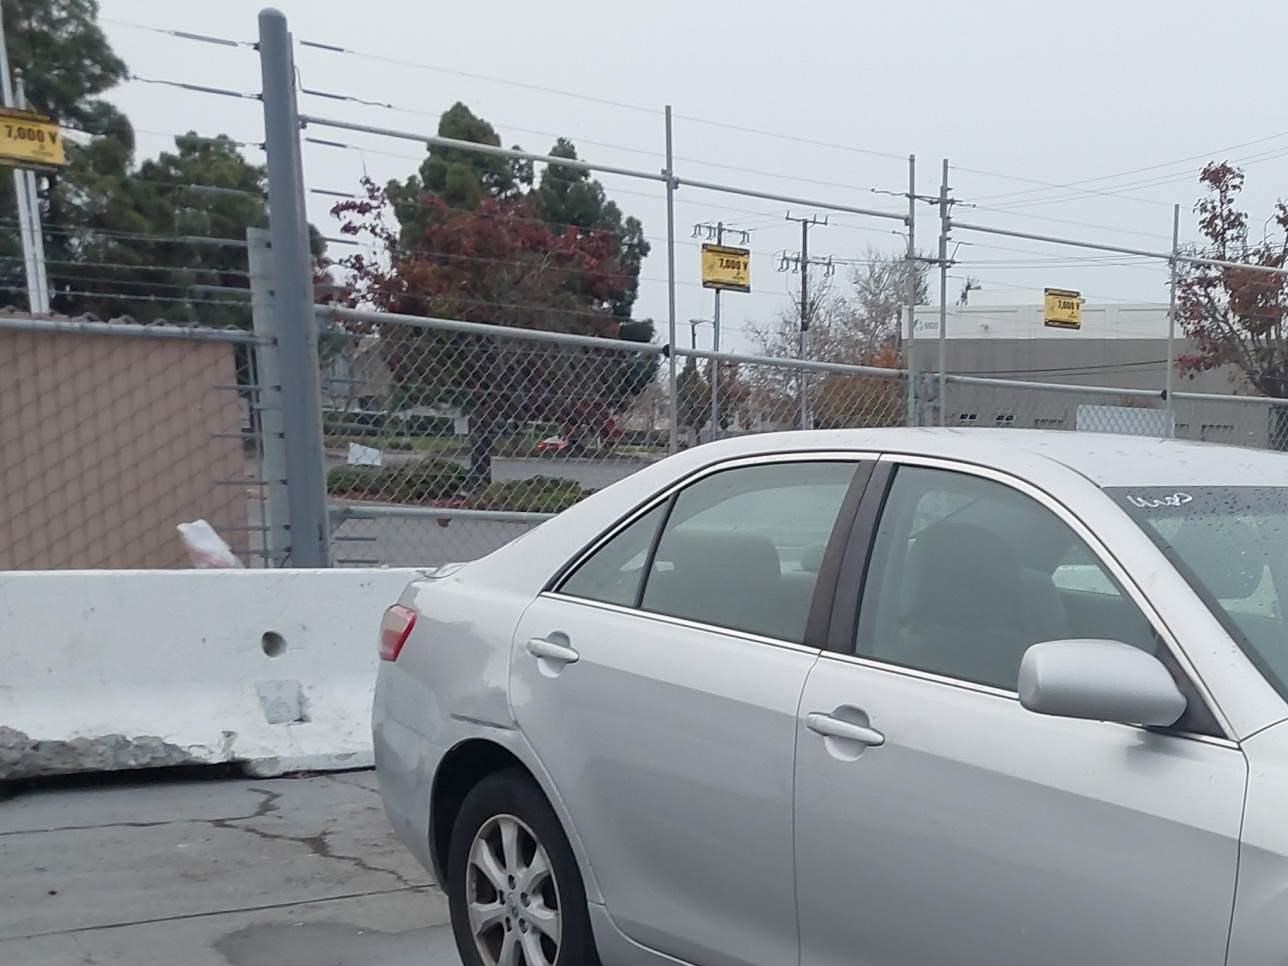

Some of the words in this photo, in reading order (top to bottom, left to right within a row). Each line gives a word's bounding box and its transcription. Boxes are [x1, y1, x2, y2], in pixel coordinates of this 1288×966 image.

[4, 124, 45, 143] 7,000
[48, 131, 58, 145] V
[718, 258, 741, 270] 7,000
